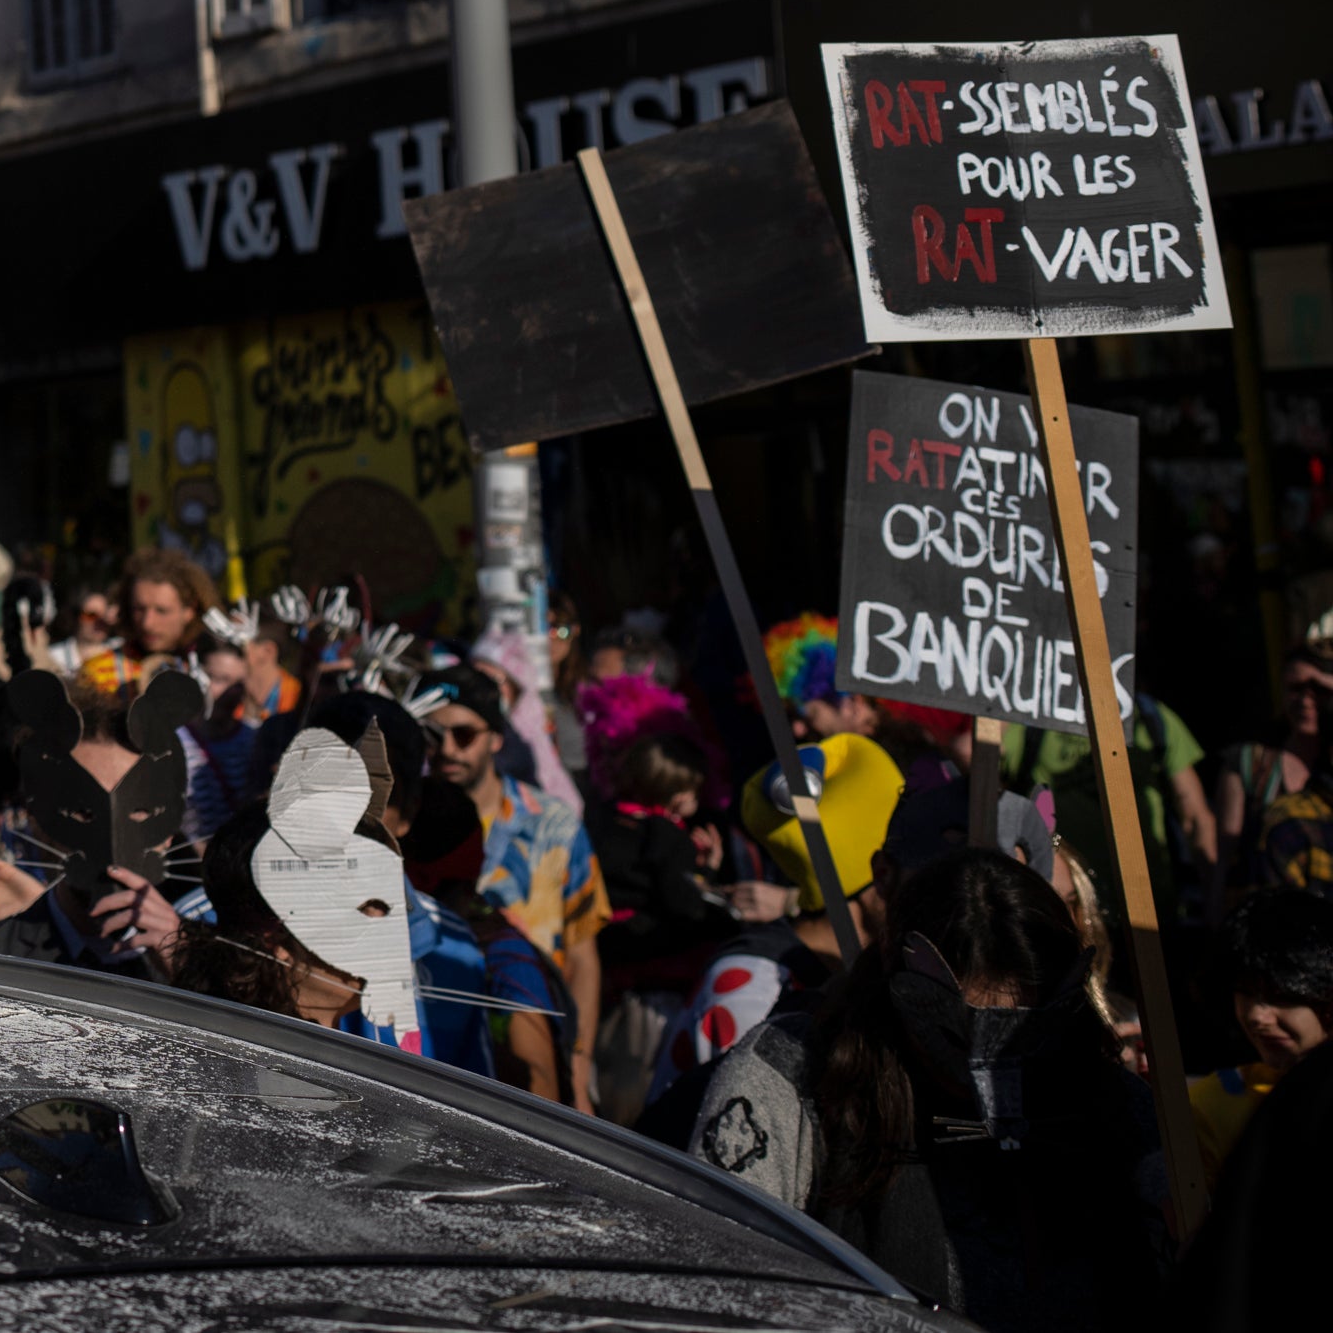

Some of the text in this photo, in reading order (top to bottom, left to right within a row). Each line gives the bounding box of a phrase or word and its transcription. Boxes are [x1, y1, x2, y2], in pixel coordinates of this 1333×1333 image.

[864, 65, 1159, 150] RAT-SSEMBLÉS
[161, 56, 770, 271] V&V HUSE
[958, 151, 1137, 202] POUR LES
[911, 204, 1194, 285] RAT-VAGER
[938, 392, 1001, 444] ON
[867, 428, 1120, 520] RATATINR
[960, 487, 1022, 520] CES
[962, 576, 1030, 627] DE
[851, 599, 1135, 724] BANQUIES
